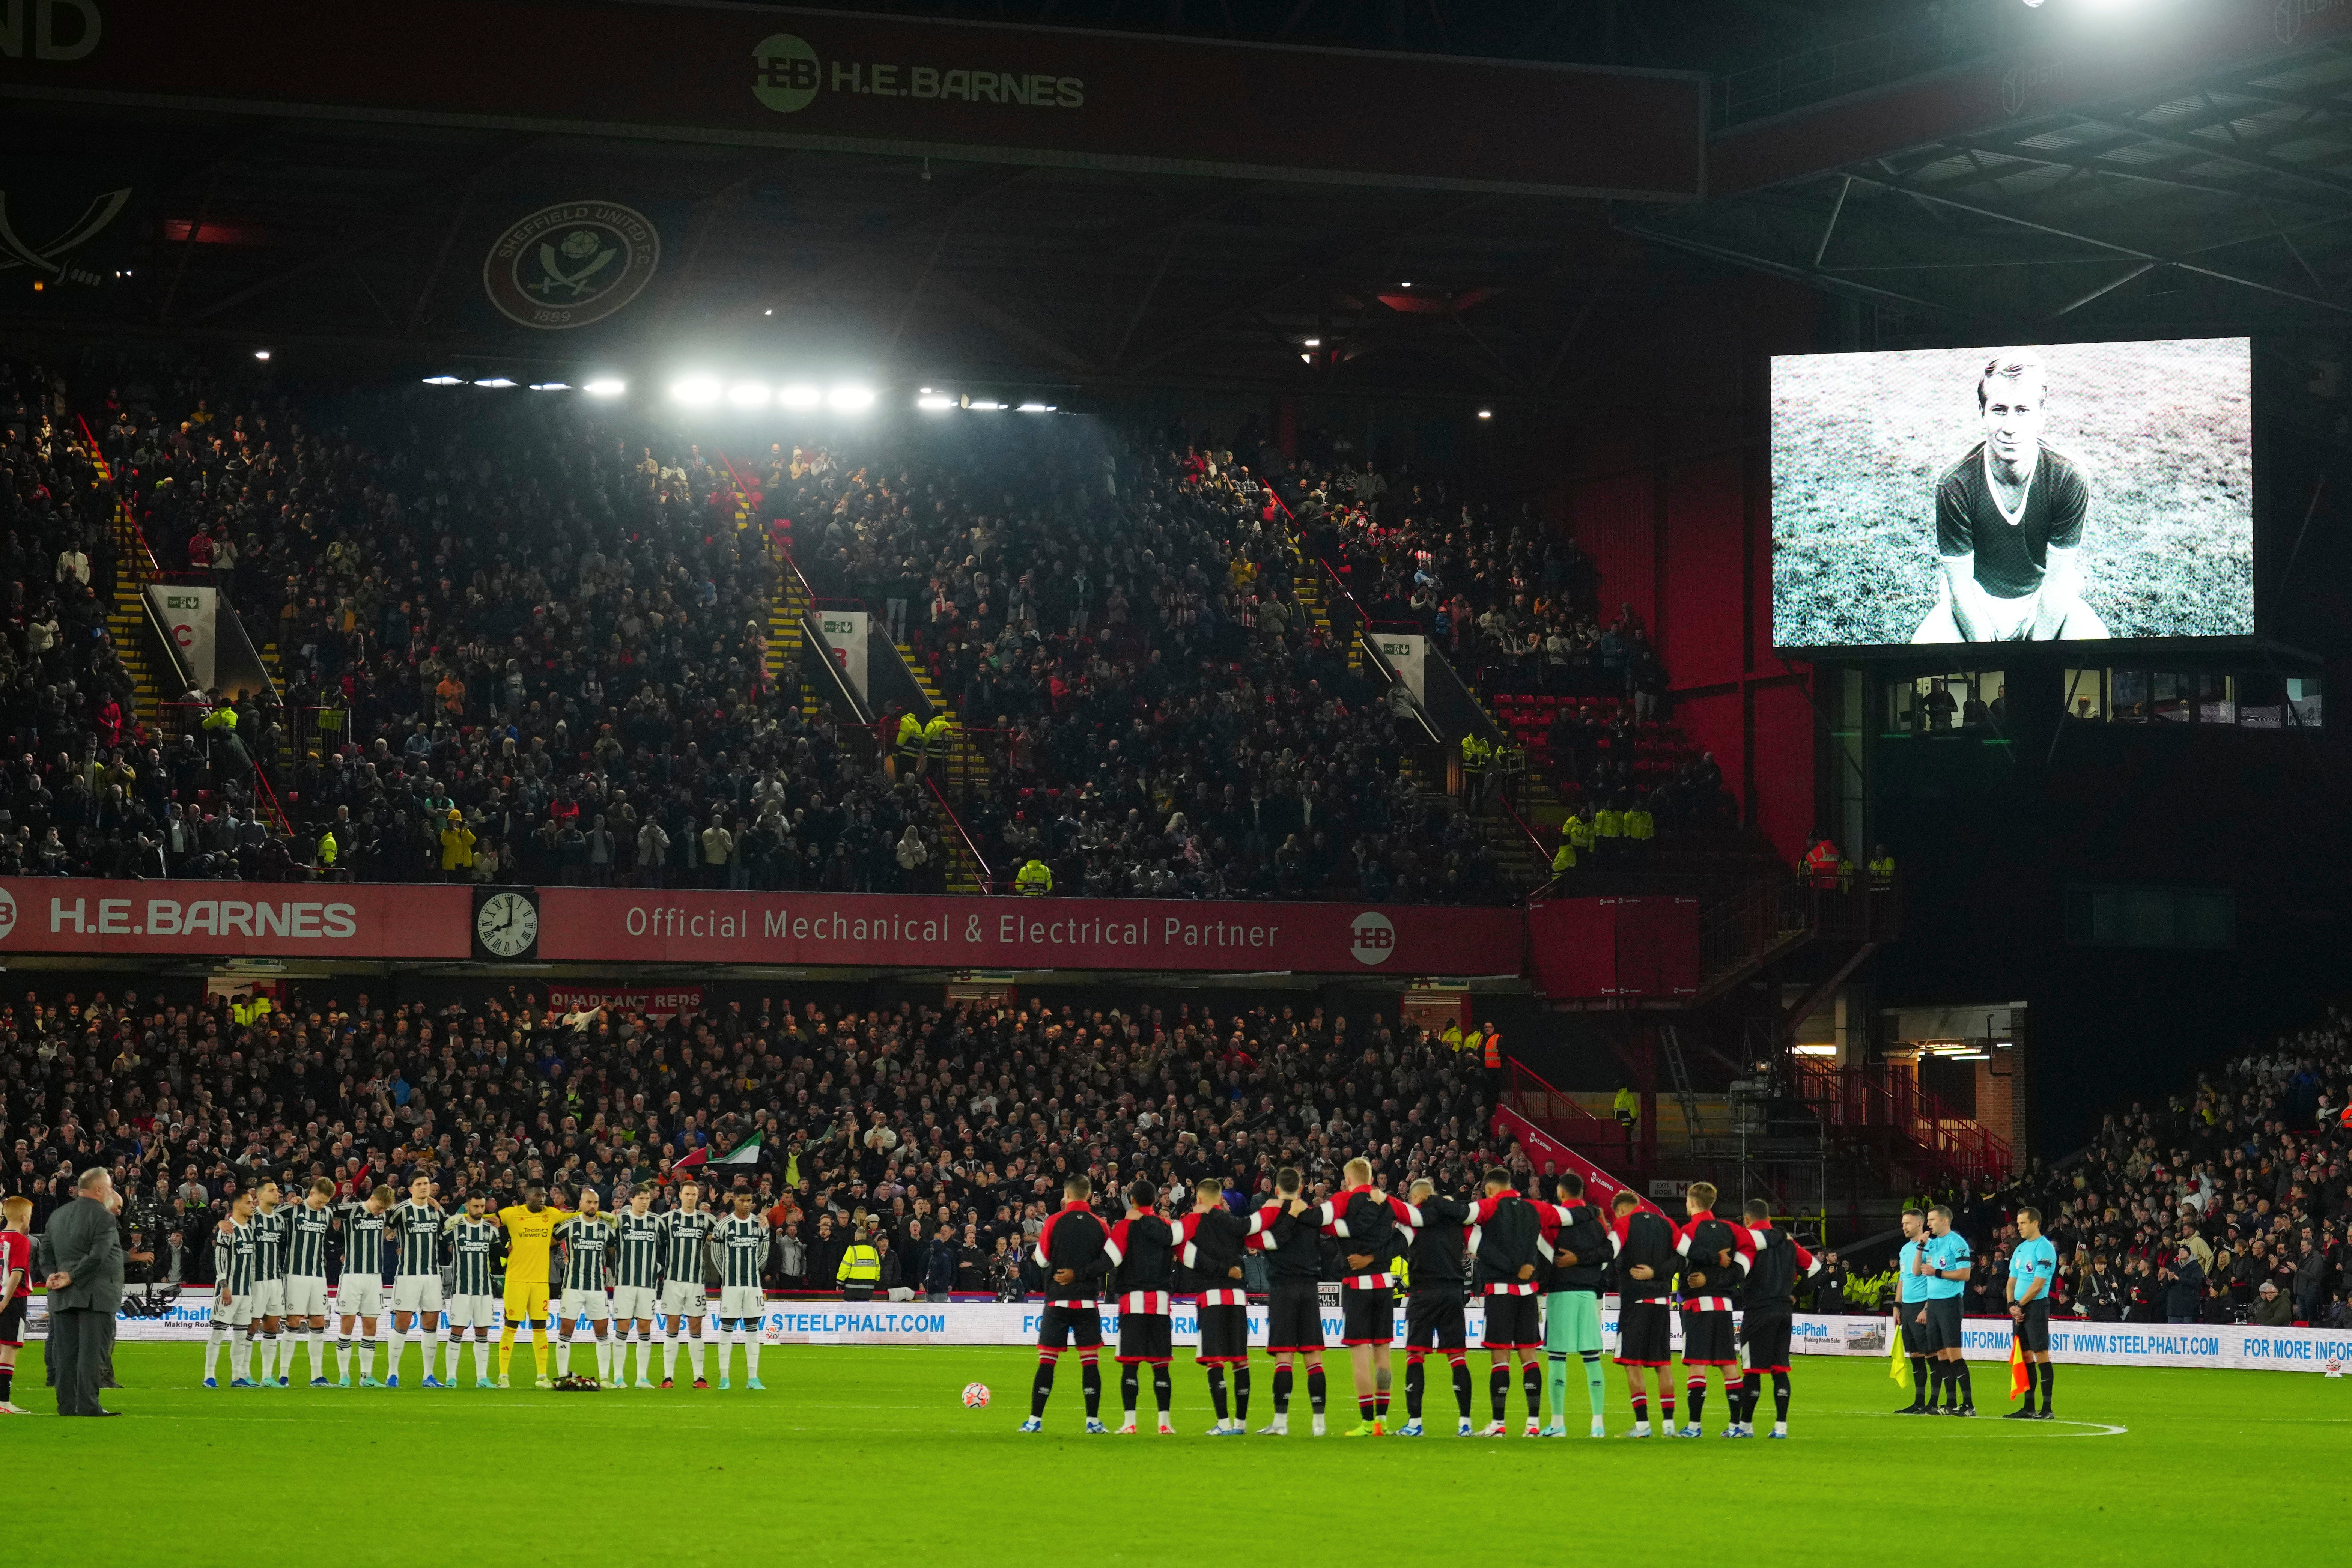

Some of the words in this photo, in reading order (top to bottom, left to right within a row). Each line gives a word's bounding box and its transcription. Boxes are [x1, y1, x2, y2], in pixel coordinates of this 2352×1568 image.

[832, 61, 1085, 108] H.E.BARNES
[499, 207, 588, 258] SHEFFIELD
[596, 208, 648, 241] UNITED
[534, 310, 571, 322] 1889
[173, 624, 192, 647] C
[51, 898, 356, 938] H.E.BARNES
[626, 907, 746, 937] Official
[765, 910, 948, 942] Mechanical
[965, 914, 983, 942] &
[1000, 915, 1148, 945] Electrical
[1165, 918, 1278, 947] Partner
[655, 994, 700, 1007] REDS
[1596, 1177, 1613, 1192] H.E.BARNES
[1676, 1183, 1688, 1195] M
[695, 1295, 706, 1307] 35
[756, 1296, 764, 1307] 10
[1791, 1323, 1827, 1336] eelPhalt
[1961, 1331, 2013, 1349] INFORMA
[2048, 1334, 2070, 1351] ISIT
[2073, 1334, 2218, 1356] WWW.STEELPHALT.COM
[2244, 1338, 2270, 1357] FOR
[2274, 1340, 2311, 1359] MORE
